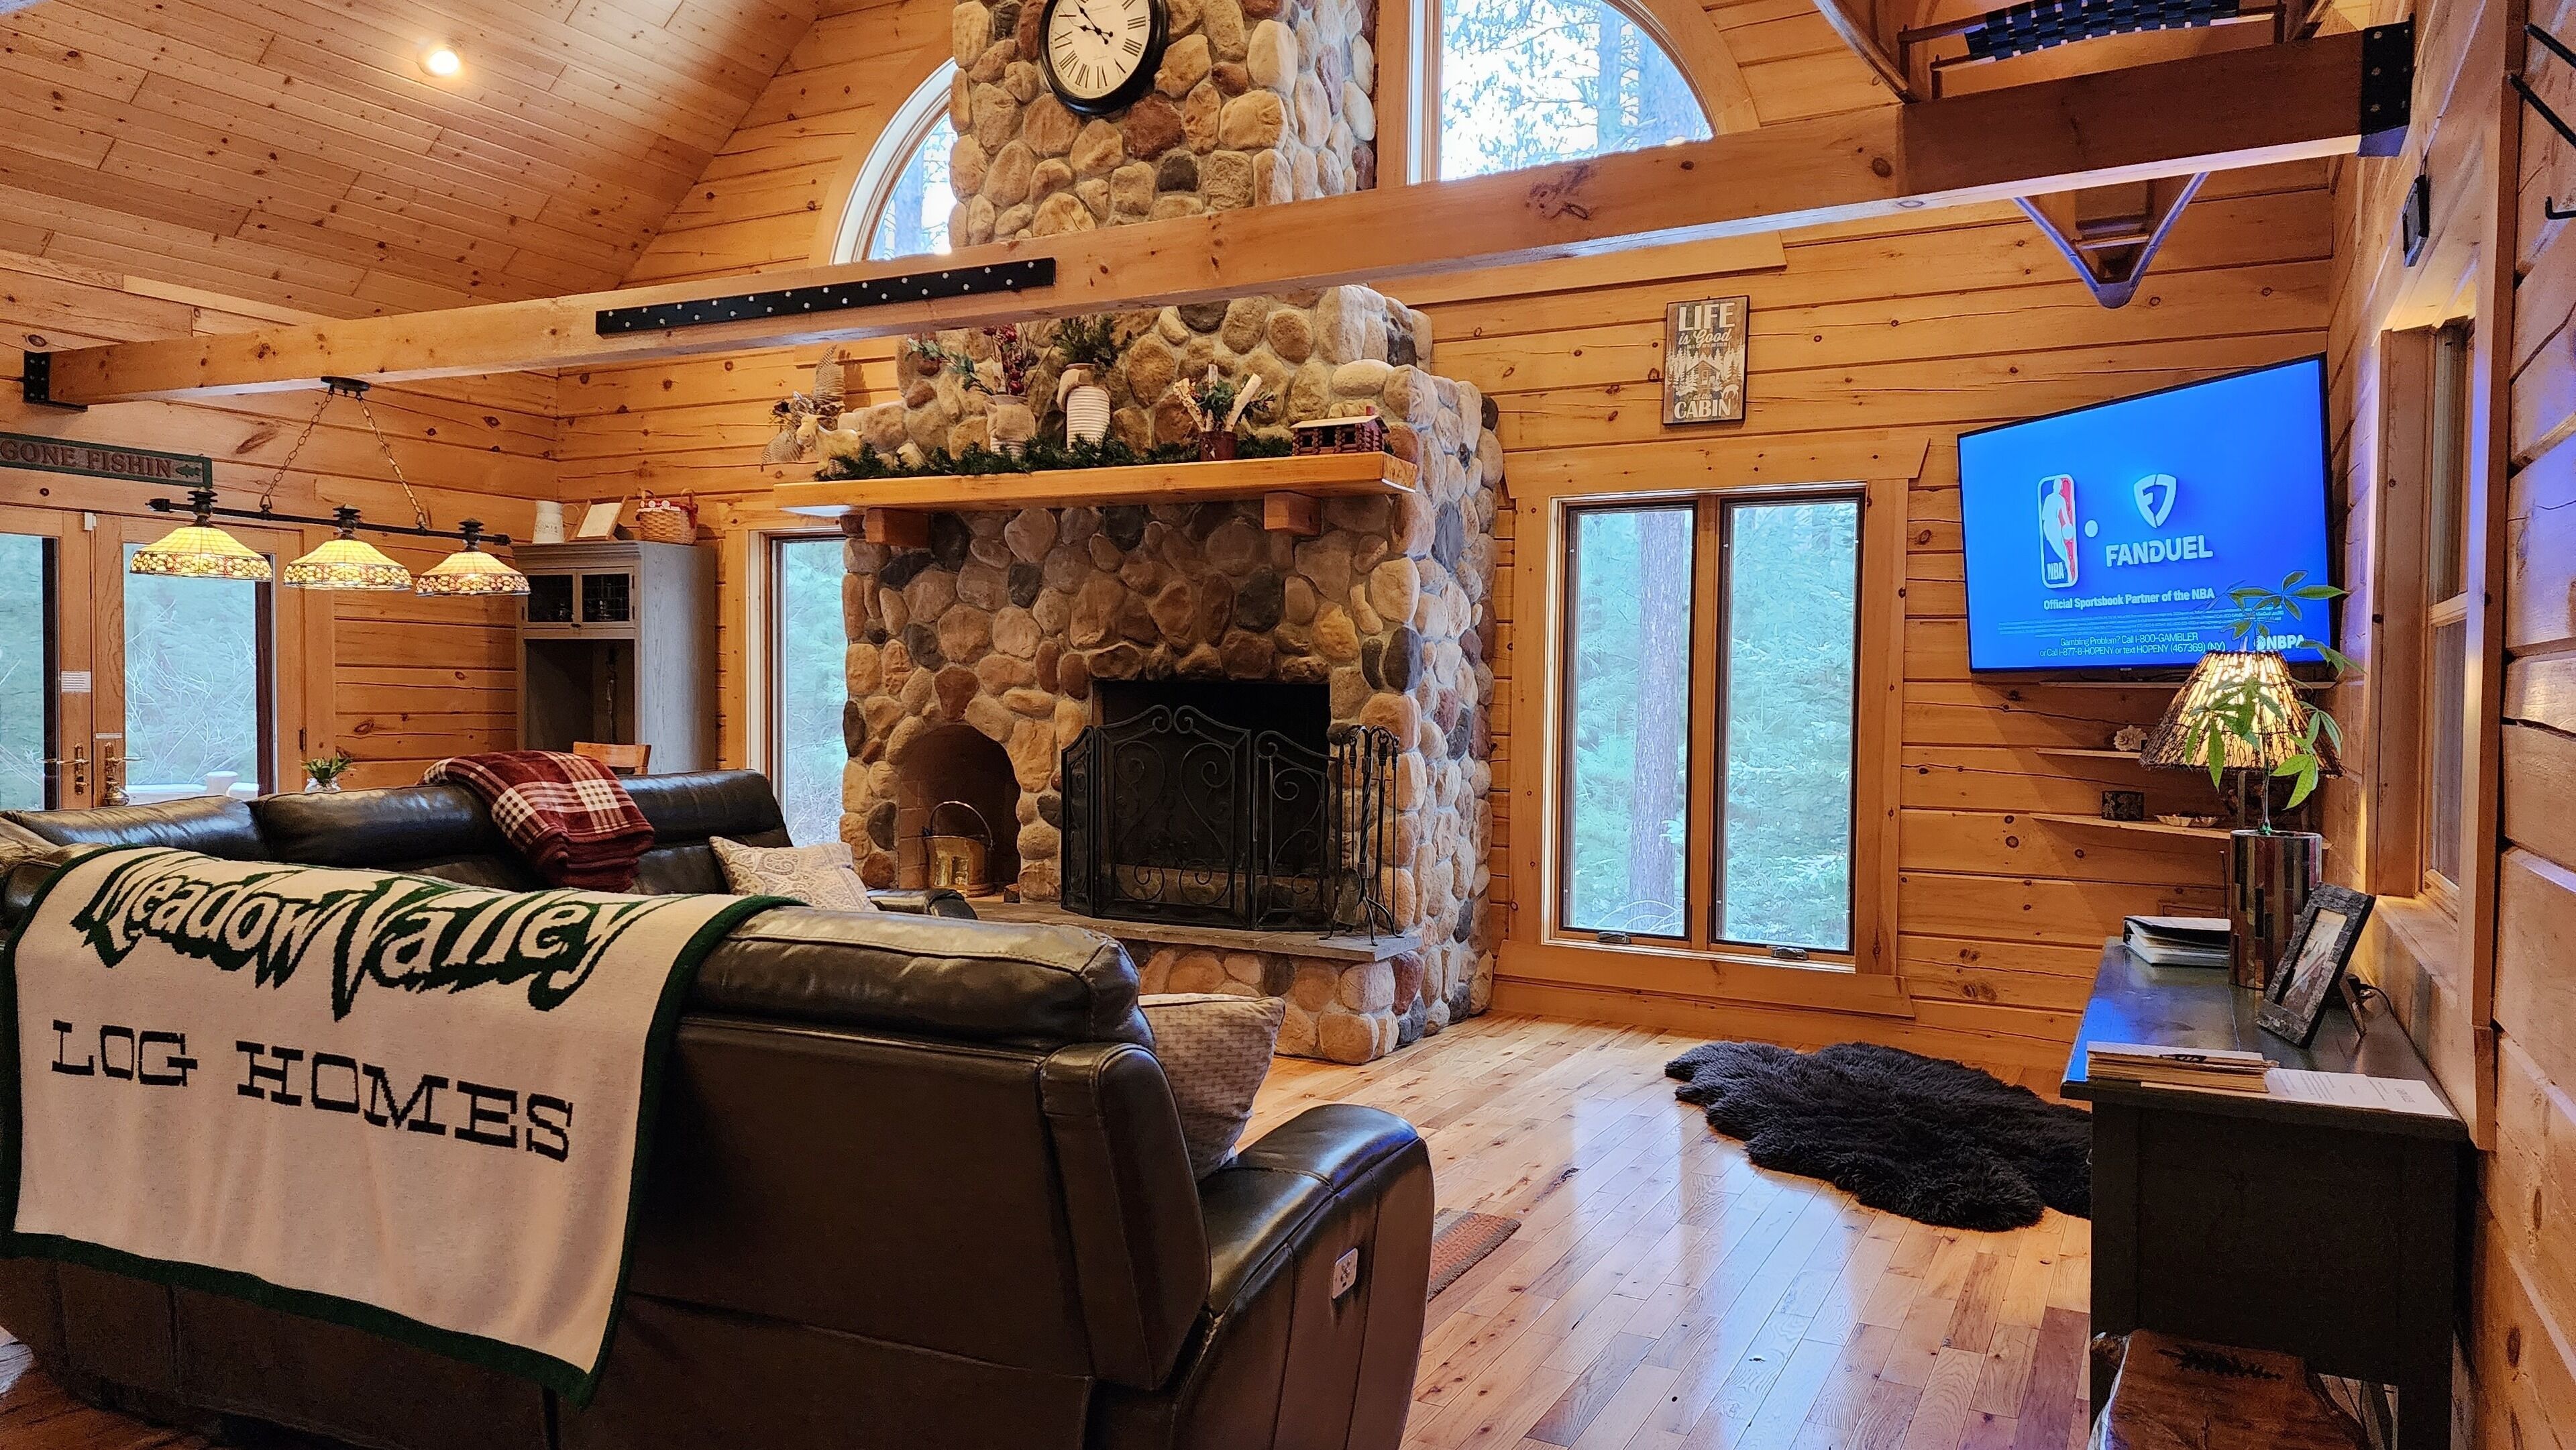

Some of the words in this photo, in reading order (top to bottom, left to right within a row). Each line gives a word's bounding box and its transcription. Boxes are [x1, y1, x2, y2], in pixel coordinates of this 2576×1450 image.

[1678, 302, 1735, 331] LIFE
[1678, 333, 1691, 345] is
[1693, 328, 1732, 348] Good
[1674, 398, 1731, 419] CABIN
[1, 439, 75, 466] GONE
[86, 449, 172, 478] FISHIN
[2106, 535, 2213, 567] FANDUEL
[2047, 562, 2065, 580] NBA
[2043, 598, 2073, 610] Official
[2075, 594, 2125, 609] Sportsbook
[2125, 592, 2159, 603] Partner
[2162, 590, 2172, 602] of
[2174, 589, 2190, 601] the
[2192, 588, 2214, 600] NBA
[2047, 648, 2059, 656] Call
[2059, 646, 2114, 656] 1-877-8-HOPENY
[2123, 645, 2135, 654] text
[2137, 643, 2169, 654] HOPENY
[2170, 641, 2206, 654] (467369)
[2207, 641, 2226, 652] (NY)
[2060, 637, 2090, 646] Gambling
[2090, 635, 2121, 645] Problem?
[2121, 635, 2134, 644] Call
[2135, 631, 2198, 643] 1-800-GAMBLER
[2267, 634, 2304, 650] NBPA
[332, 876, 708, 1022] Valley
[52, 1019, 198, 1087] LOG
[236, 1040, 574, 1162] HOMES
